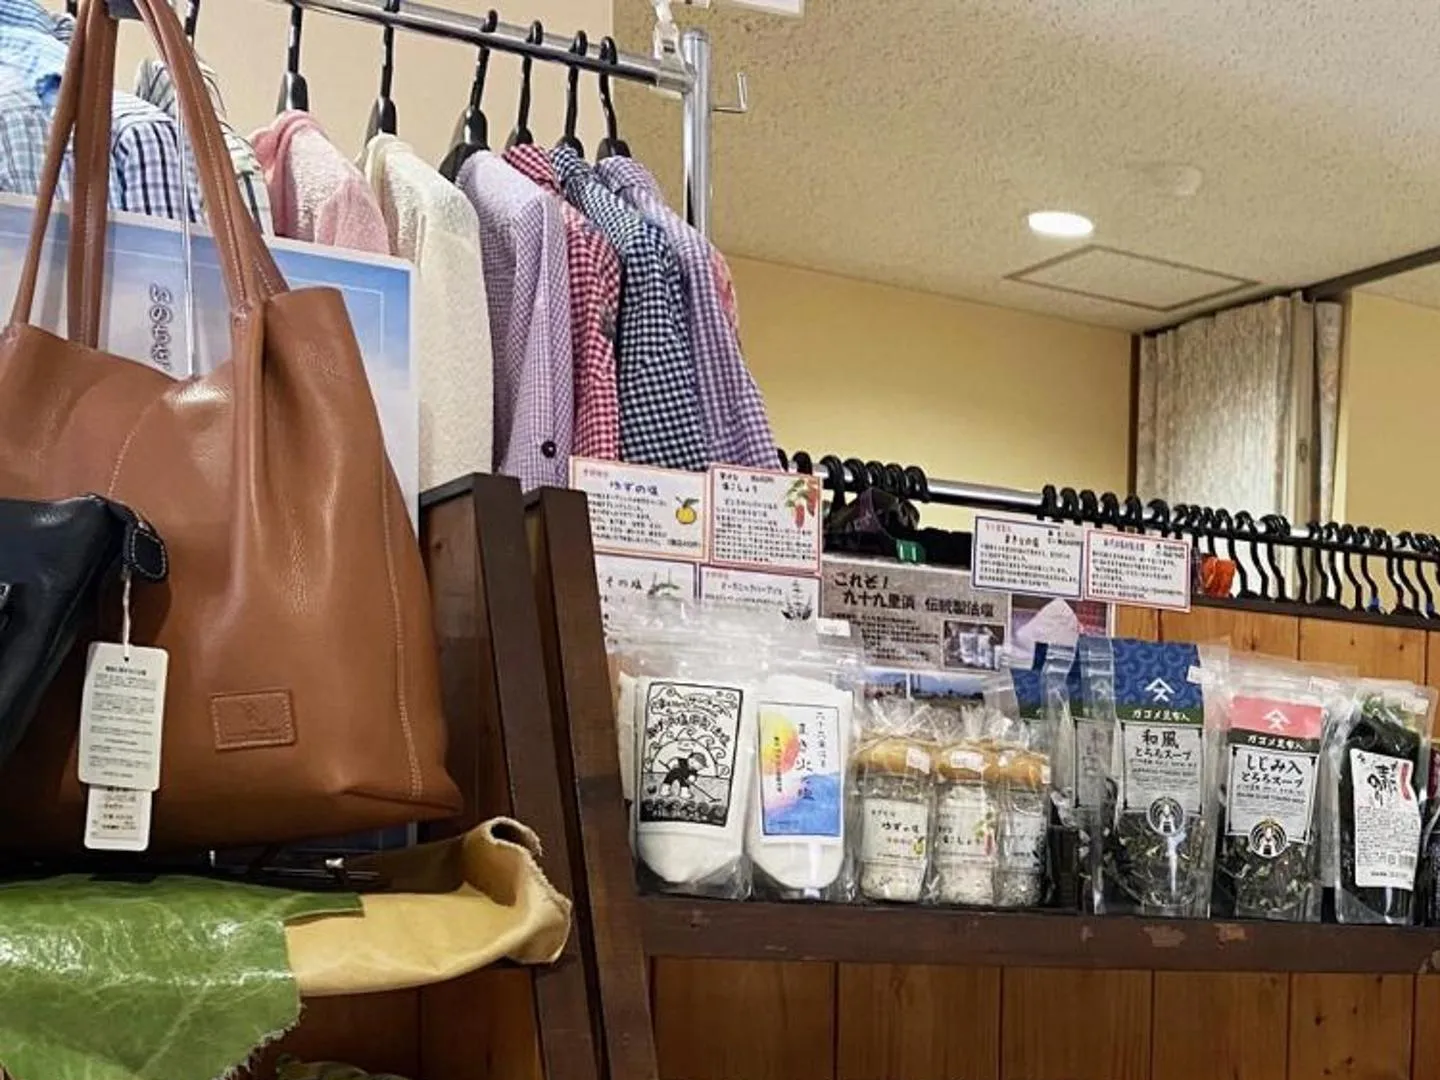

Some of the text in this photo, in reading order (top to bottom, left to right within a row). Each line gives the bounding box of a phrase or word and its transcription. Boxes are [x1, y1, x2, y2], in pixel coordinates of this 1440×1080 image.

[1142, 728, 1180, 750] 和風
[1246, 753, 1303, 775] しじみ入
